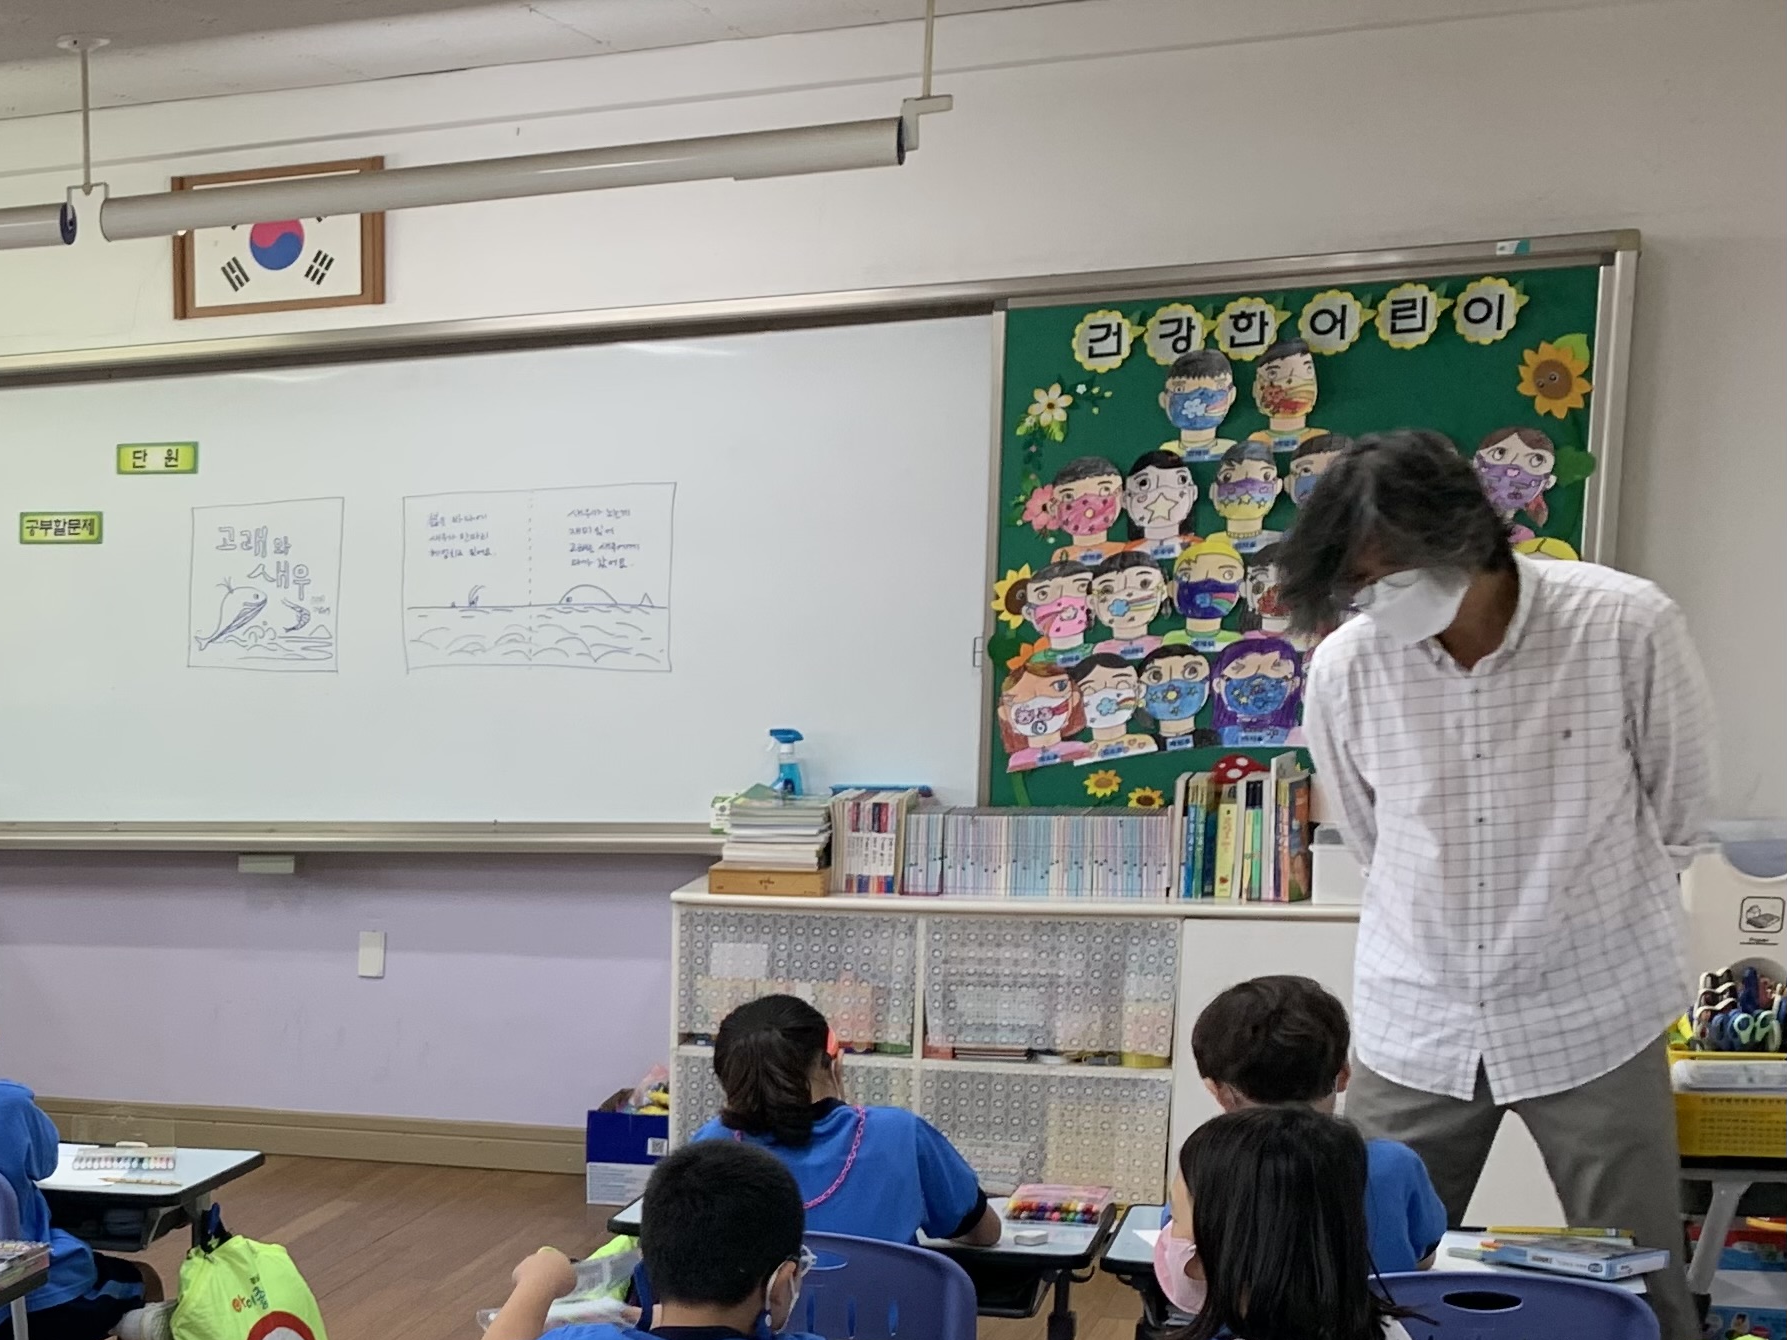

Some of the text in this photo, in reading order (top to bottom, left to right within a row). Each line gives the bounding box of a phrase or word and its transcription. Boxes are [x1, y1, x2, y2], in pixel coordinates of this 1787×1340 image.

[1088, 294, 1507, 359] 건강한 어린이
[25, 517, 95, 537] 공부할문제
[247, 560, 311, 601] 새우
